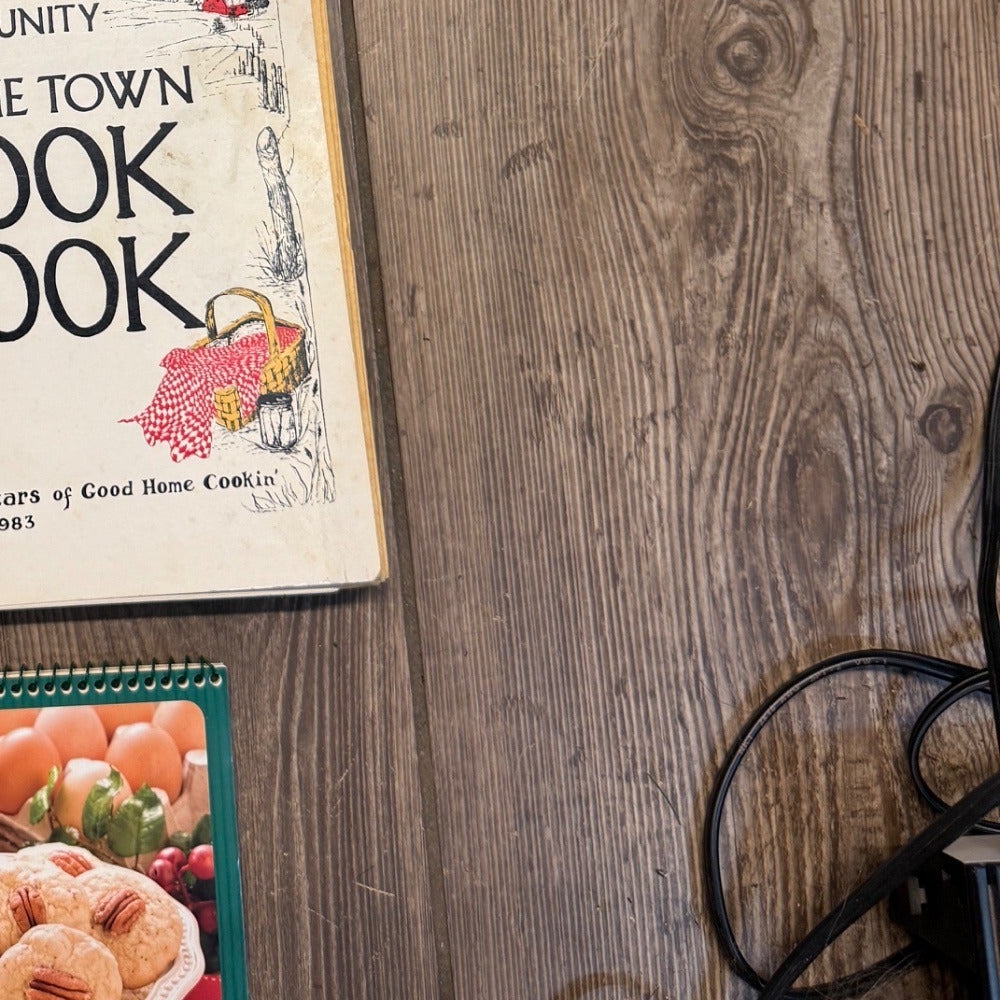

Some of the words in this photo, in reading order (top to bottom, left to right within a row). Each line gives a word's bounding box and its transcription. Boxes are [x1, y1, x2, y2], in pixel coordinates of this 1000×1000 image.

[37, 65, 194, 113] TOWN
[52, 486, 73, 511] of
[81, 480, 134, 500] Good
[142, 477, 196, 495] Home
[203, 468, 279, 491] Cookin'
